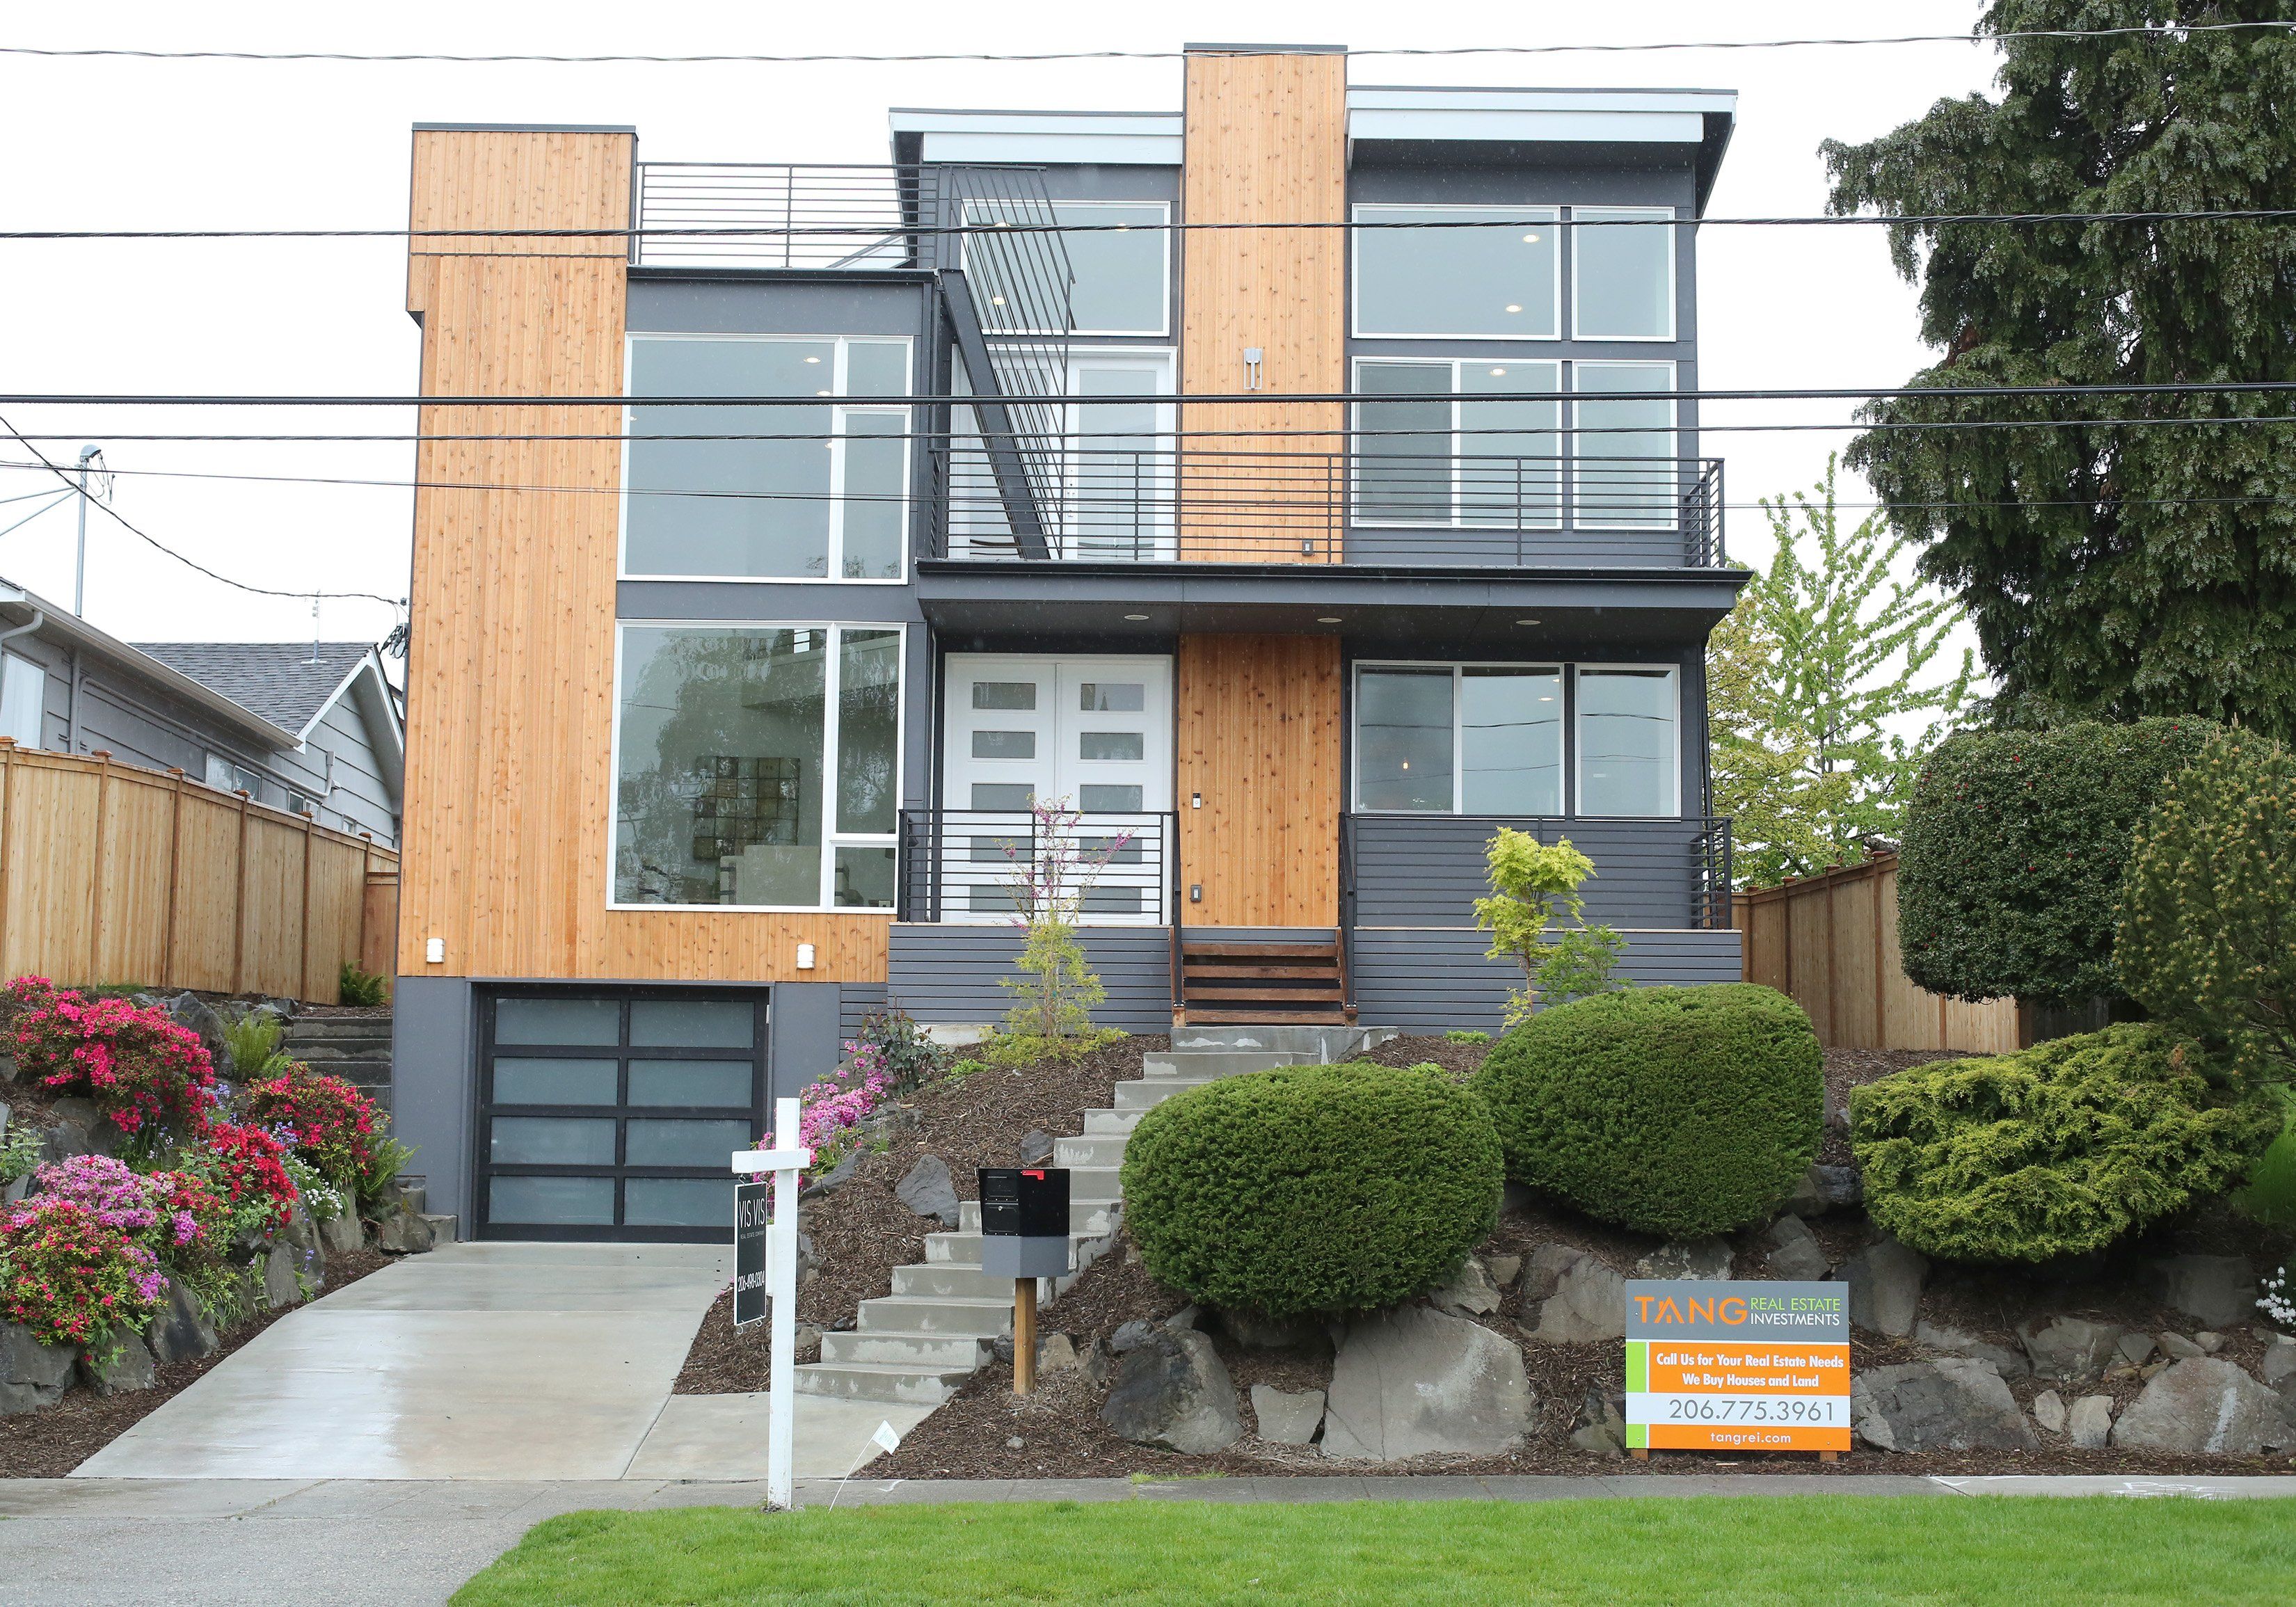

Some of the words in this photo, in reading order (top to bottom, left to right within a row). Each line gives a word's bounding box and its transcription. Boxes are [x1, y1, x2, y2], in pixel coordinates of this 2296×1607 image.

[739, 1199, 751, 1228] VIS
[753, 1198, 765, 1225] VIS
[738, 1270, 765, 1292] 206-498-0304
[1634, 1296, 1748, 1325] TANG
[1751, 1297, 1785, 1311] REAL
[1790, 1297, 1841, 1311] ESTATE
[1751, 1312, 1840, 1325] INVESTMENTS
[1656, 1352, 1677, 1366] Call
[1680, 1353, 1695, 1366] Us
[1697, 1353, 1714, 1366] for
[1716, 1354, 1742, 1366] Your
[1745, 1354, 1770, 1367] Real
[1773, 1354, 1806, 1367] Estate
[1809, 1355, 1844, 1368] Needs
[1682, 1373, 1700, 1385] We
[1703, 1373, 1724, 1389] Buy
[1727, 1373, 1766, 1386] Houses
[1768, 1374, 1789, 1386] and
[1792, 1375, 1819, 1387] Land
[1669, 1399, 1833, 1421] 206.775.3961
[1710, 1432, 1792, 1446] tangrei.com
